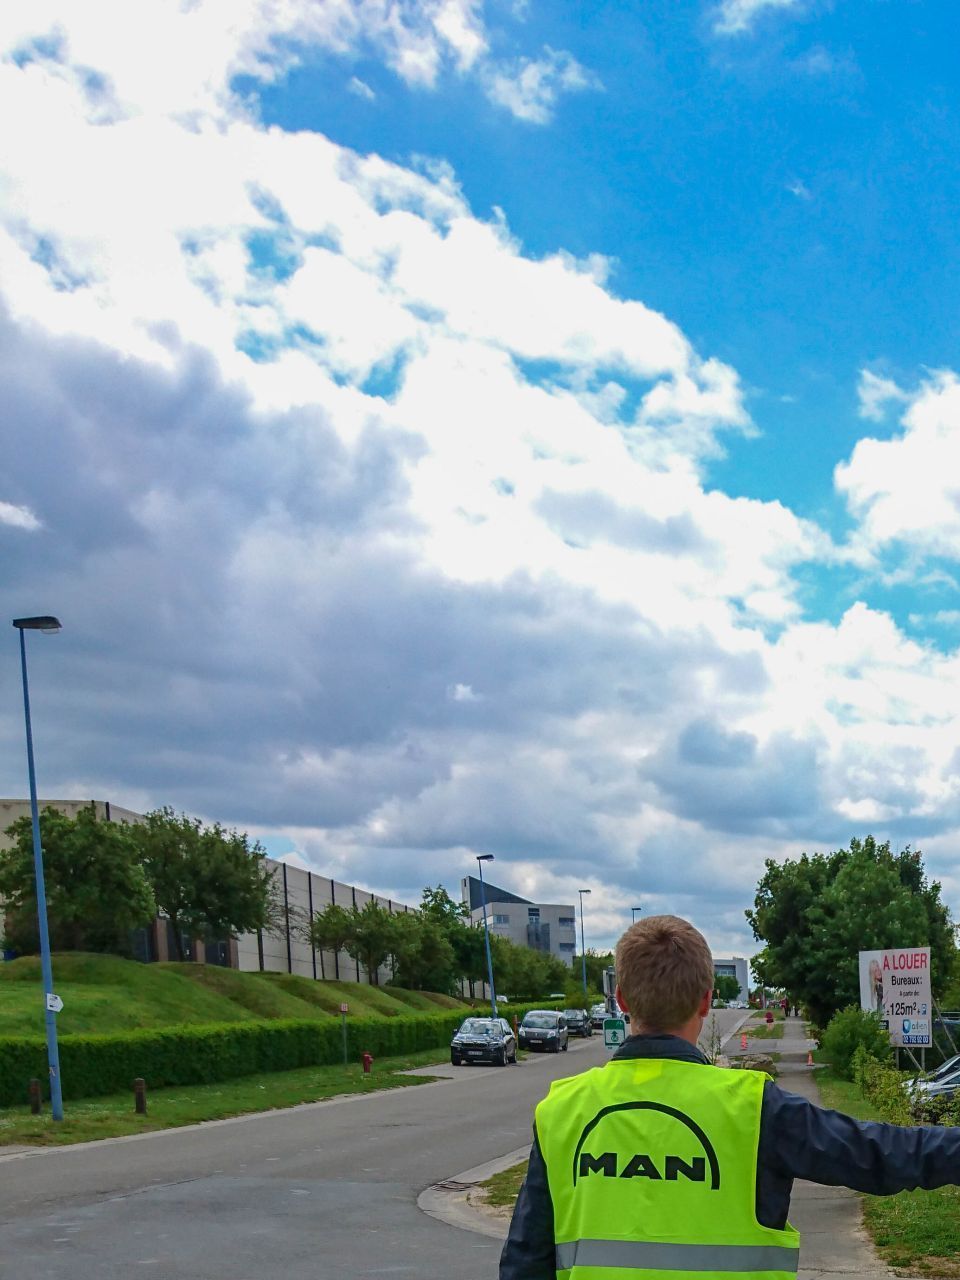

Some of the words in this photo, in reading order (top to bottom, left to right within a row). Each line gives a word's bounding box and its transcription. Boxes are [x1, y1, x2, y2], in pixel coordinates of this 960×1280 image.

[884, 955, 890, 970] A
[893, 953, 927, 970] LOUER
[892, 976, 922, 985] Bureaux:
[579, 1153, 706, 1182] MAN
